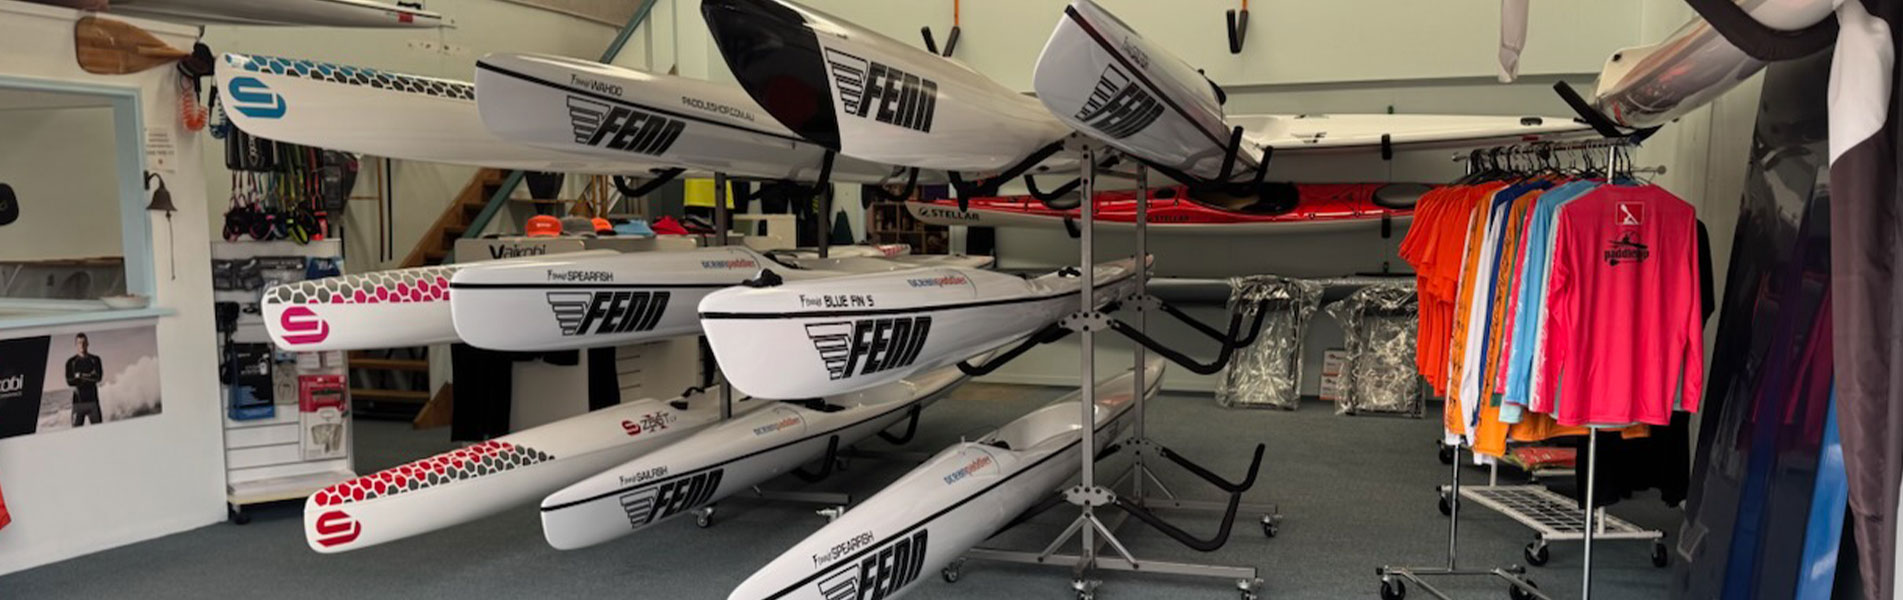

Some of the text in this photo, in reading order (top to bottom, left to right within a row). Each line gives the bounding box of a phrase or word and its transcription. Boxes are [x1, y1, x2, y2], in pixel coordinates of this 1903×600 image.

[930, 209, 980, 222] STELLAR
[567, 271, 614, 282] SPEARFISH
[824, 295, 849, 308] BLUE
[831, 531, 875, 560] SPEARFISH
